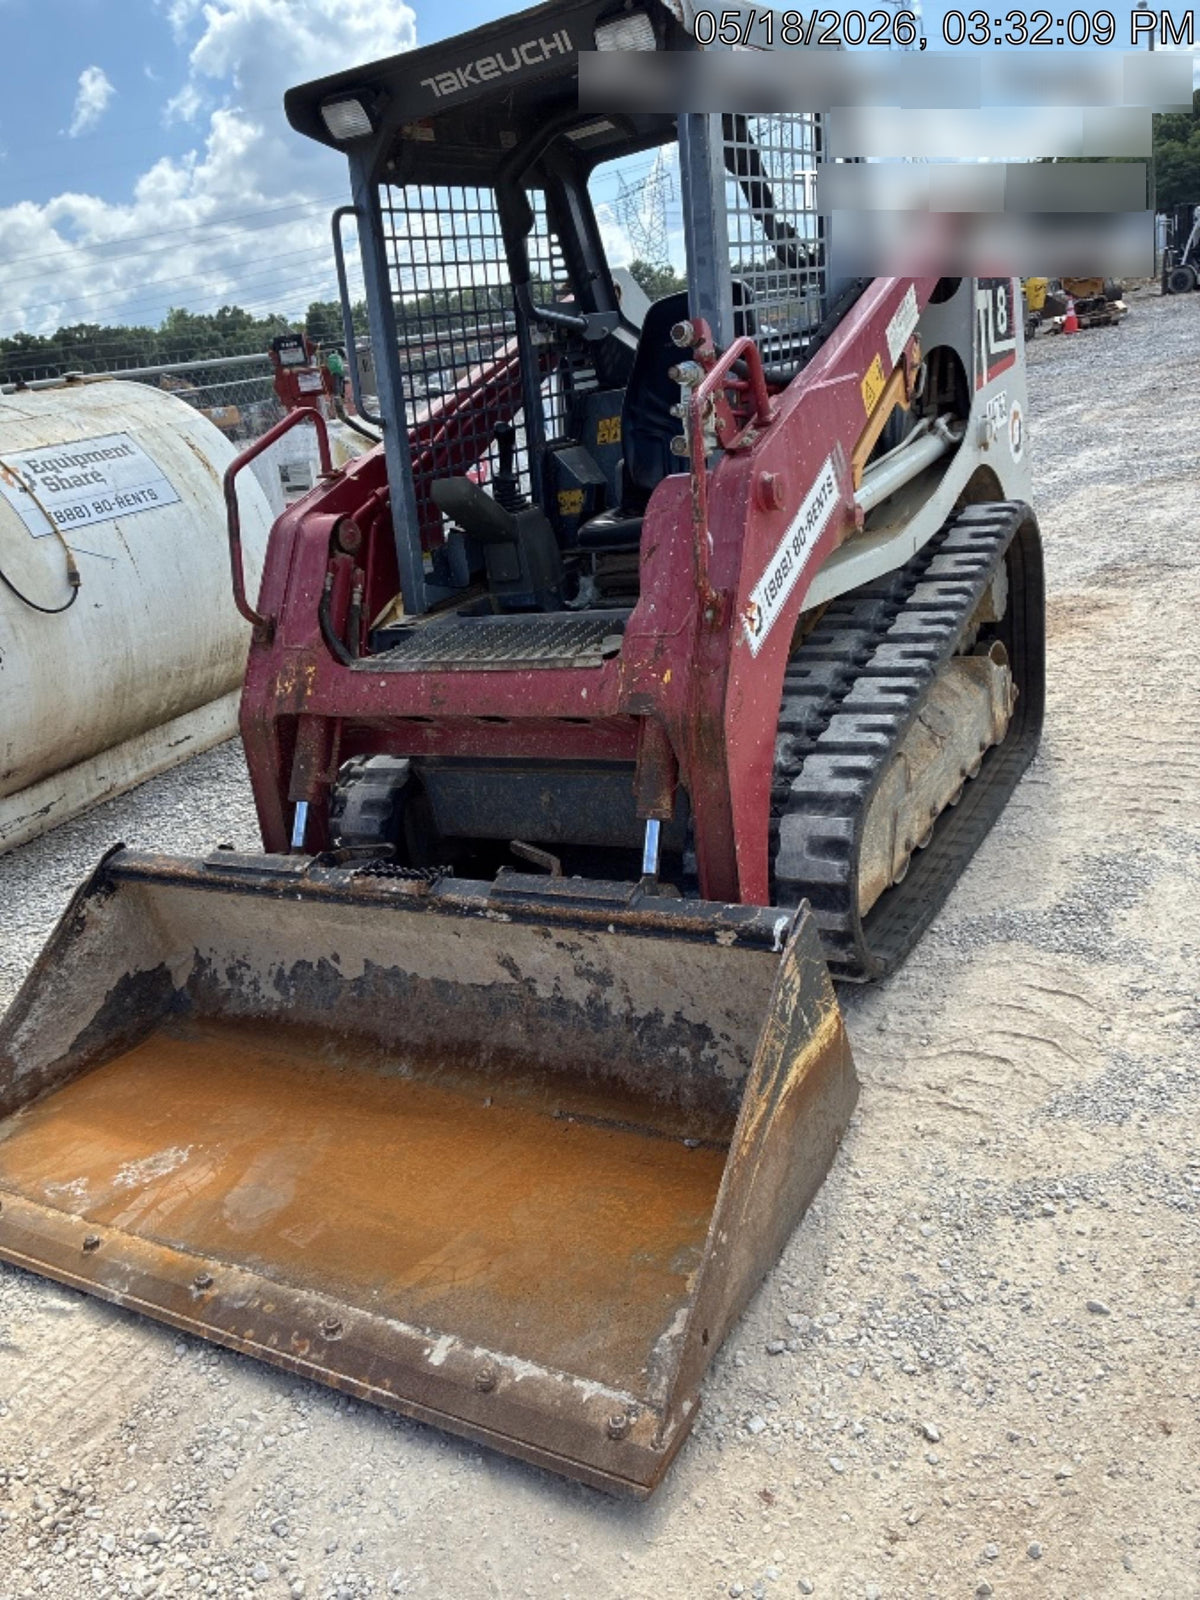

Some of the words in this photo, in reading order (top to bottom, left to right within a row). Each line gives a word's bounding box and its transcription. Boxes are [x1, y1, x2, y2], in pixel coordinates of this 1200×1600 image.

[25, 442, 136, 476] Equipment
[92, 488, 159, 515] 80-RENTS
[763, 549, 794, 608] (888)
[791, 474, 834, 558] 80-RENTS
